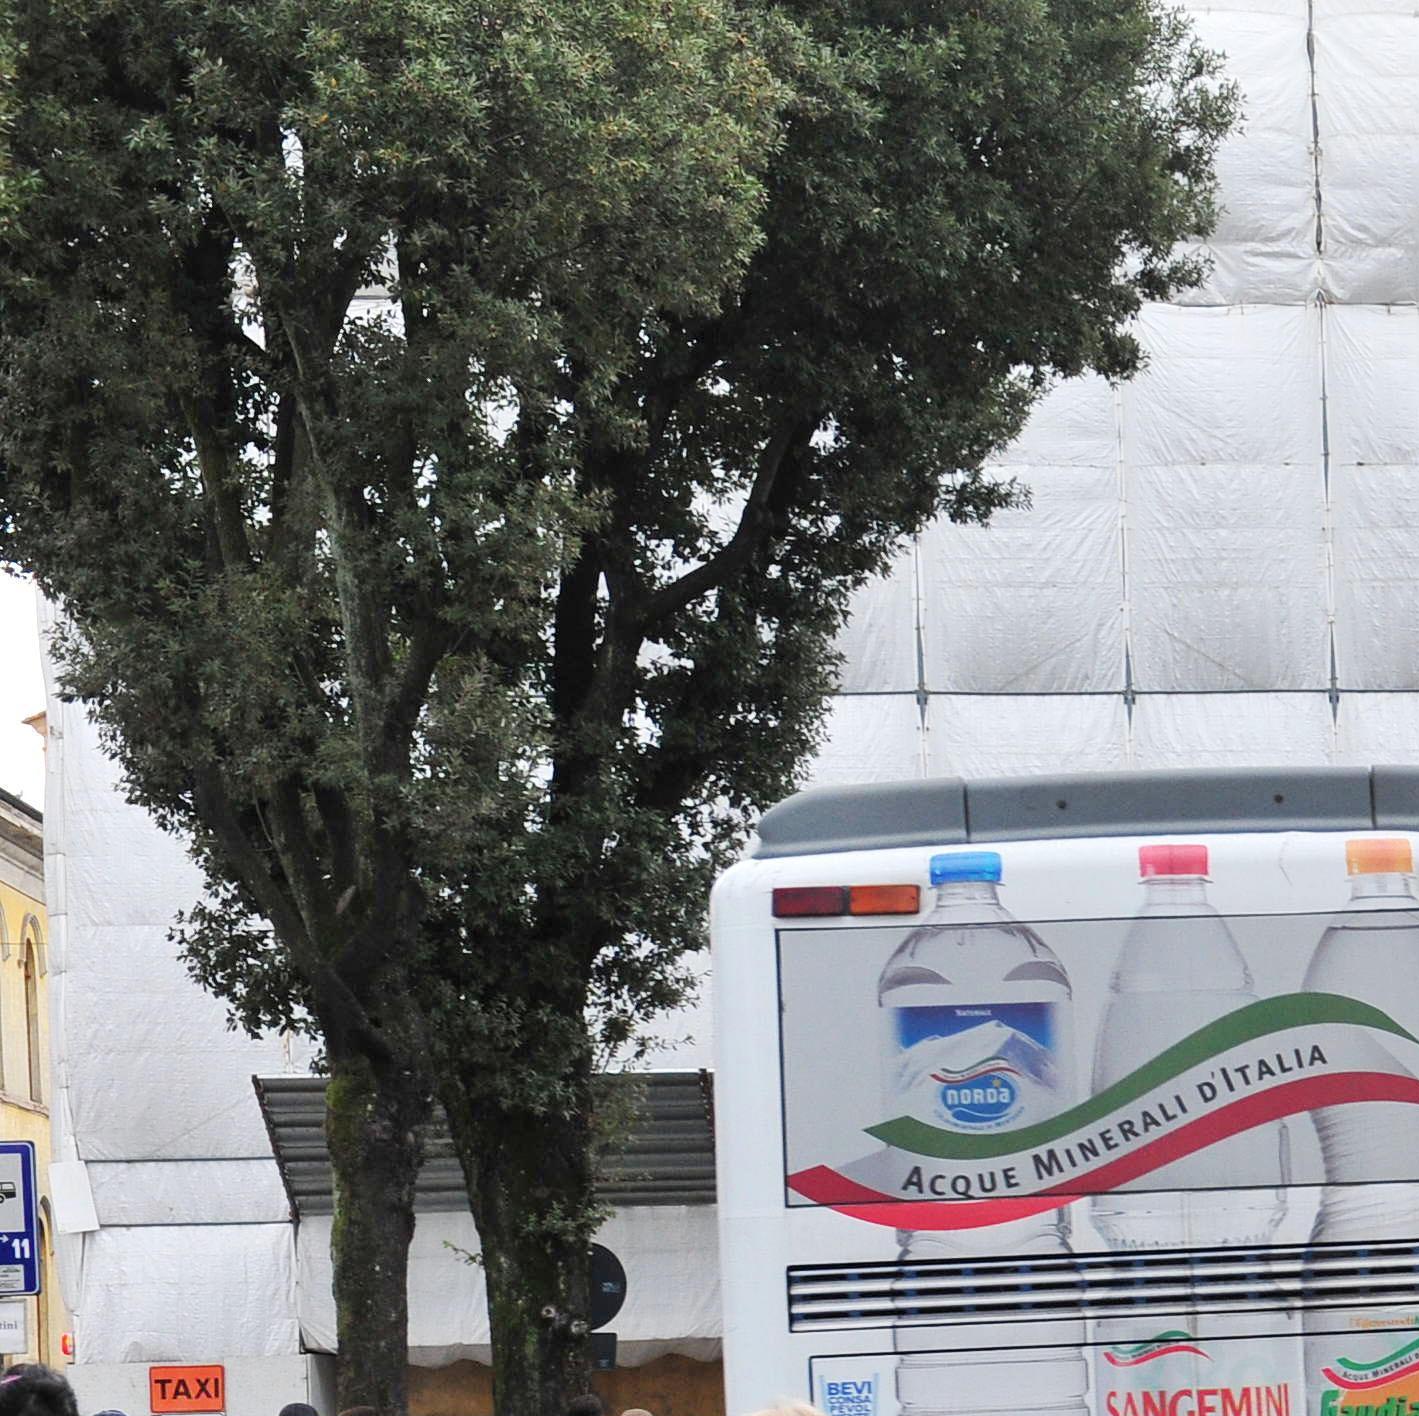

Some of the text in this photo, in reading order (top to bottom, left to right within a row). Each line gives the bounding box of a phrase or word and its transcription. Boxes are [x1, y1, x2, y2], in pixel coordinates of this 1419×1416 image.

[11, 1238, 31, 1259] 11
[154, 1377, 220, 1400] TAXI
[827, 1381, 873, 1396] BEVI
